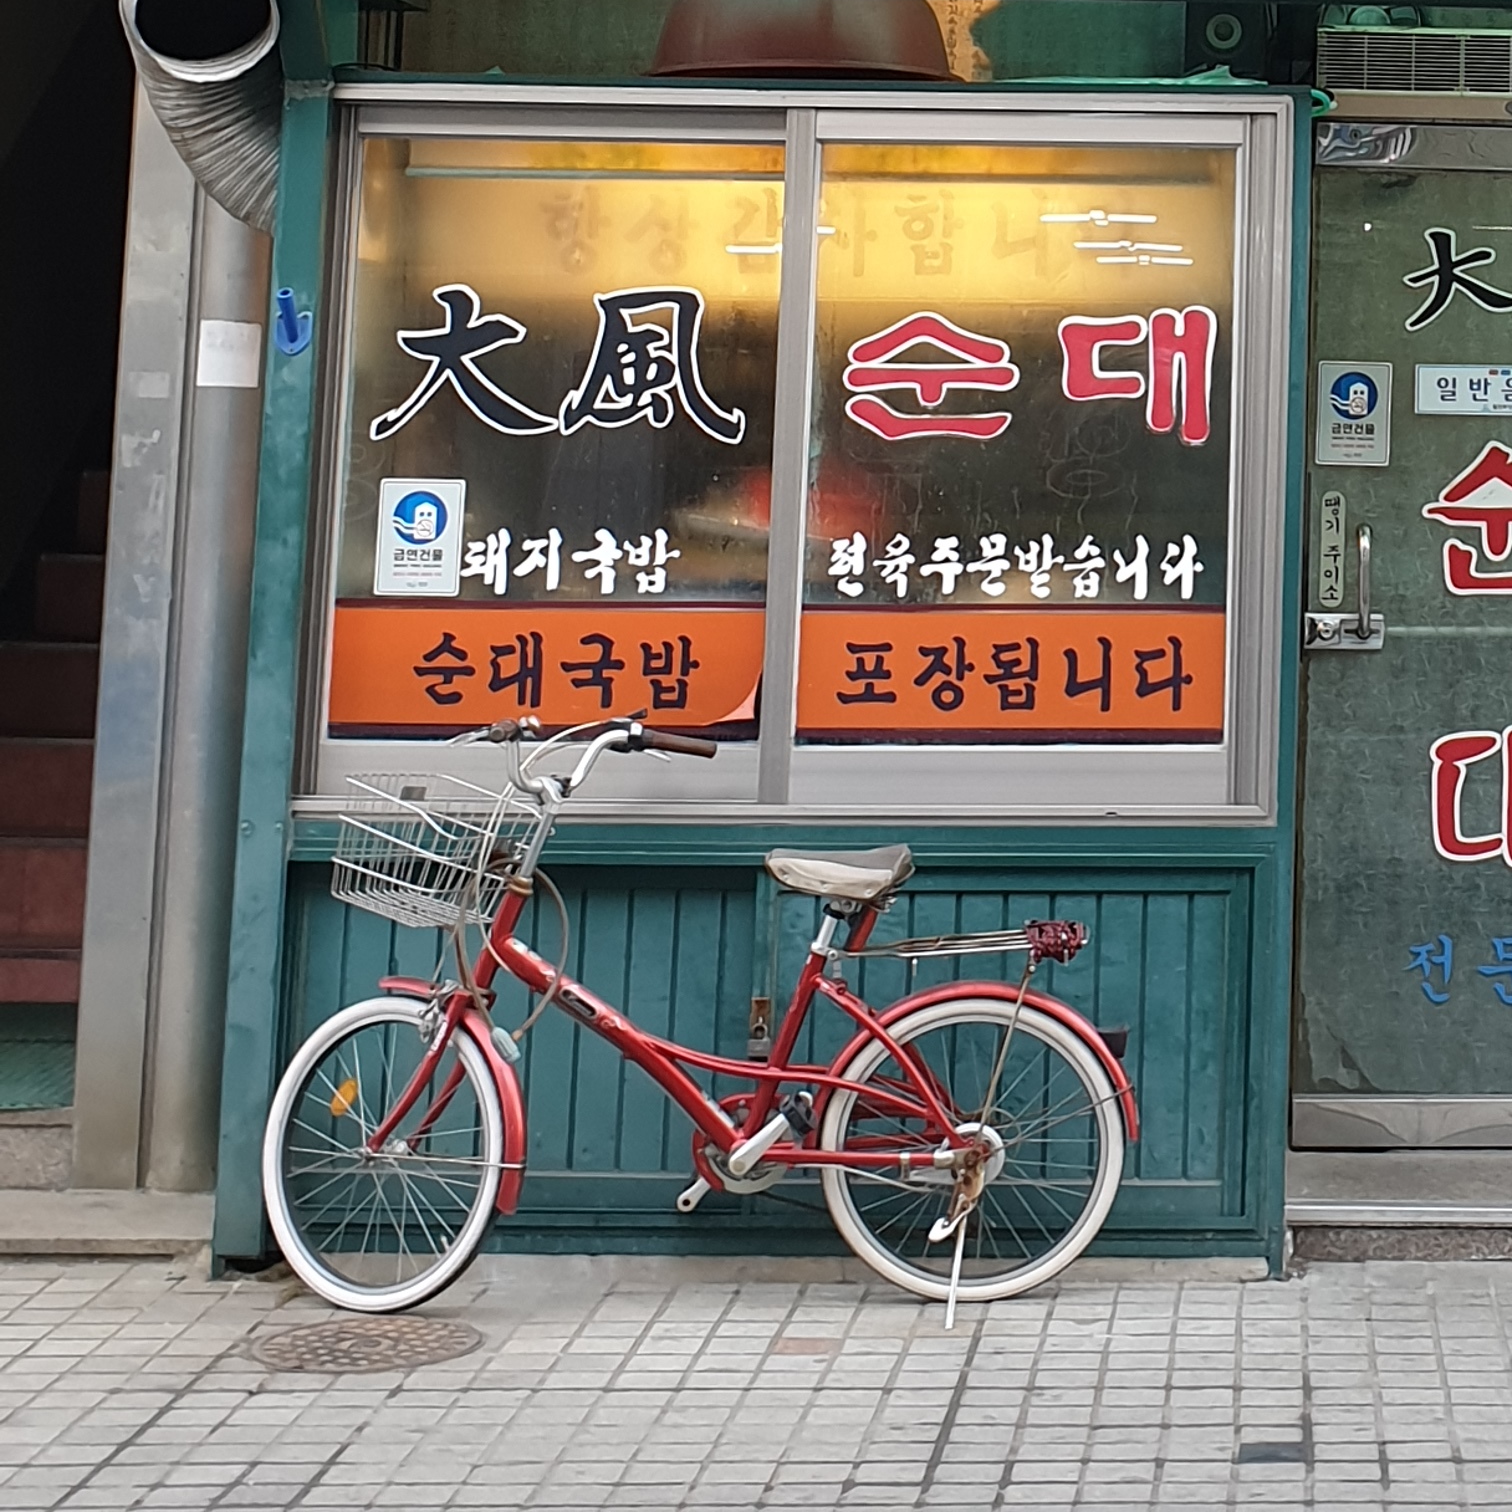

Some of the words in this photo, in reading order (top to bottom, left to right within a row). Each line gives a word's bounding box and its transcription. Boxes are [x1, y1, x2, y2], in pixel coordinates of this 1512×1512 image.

[369, 284, 747, 445] 大風
[842, 305, 1218, 445] 순대
[460, 527, 681, 595] 돼지국밥
[1321, 544, 1342, 601] 주이소
[412, 630, 701, 710] 순대국밥
[835, 634, 1194, 713] 포장됩니다
